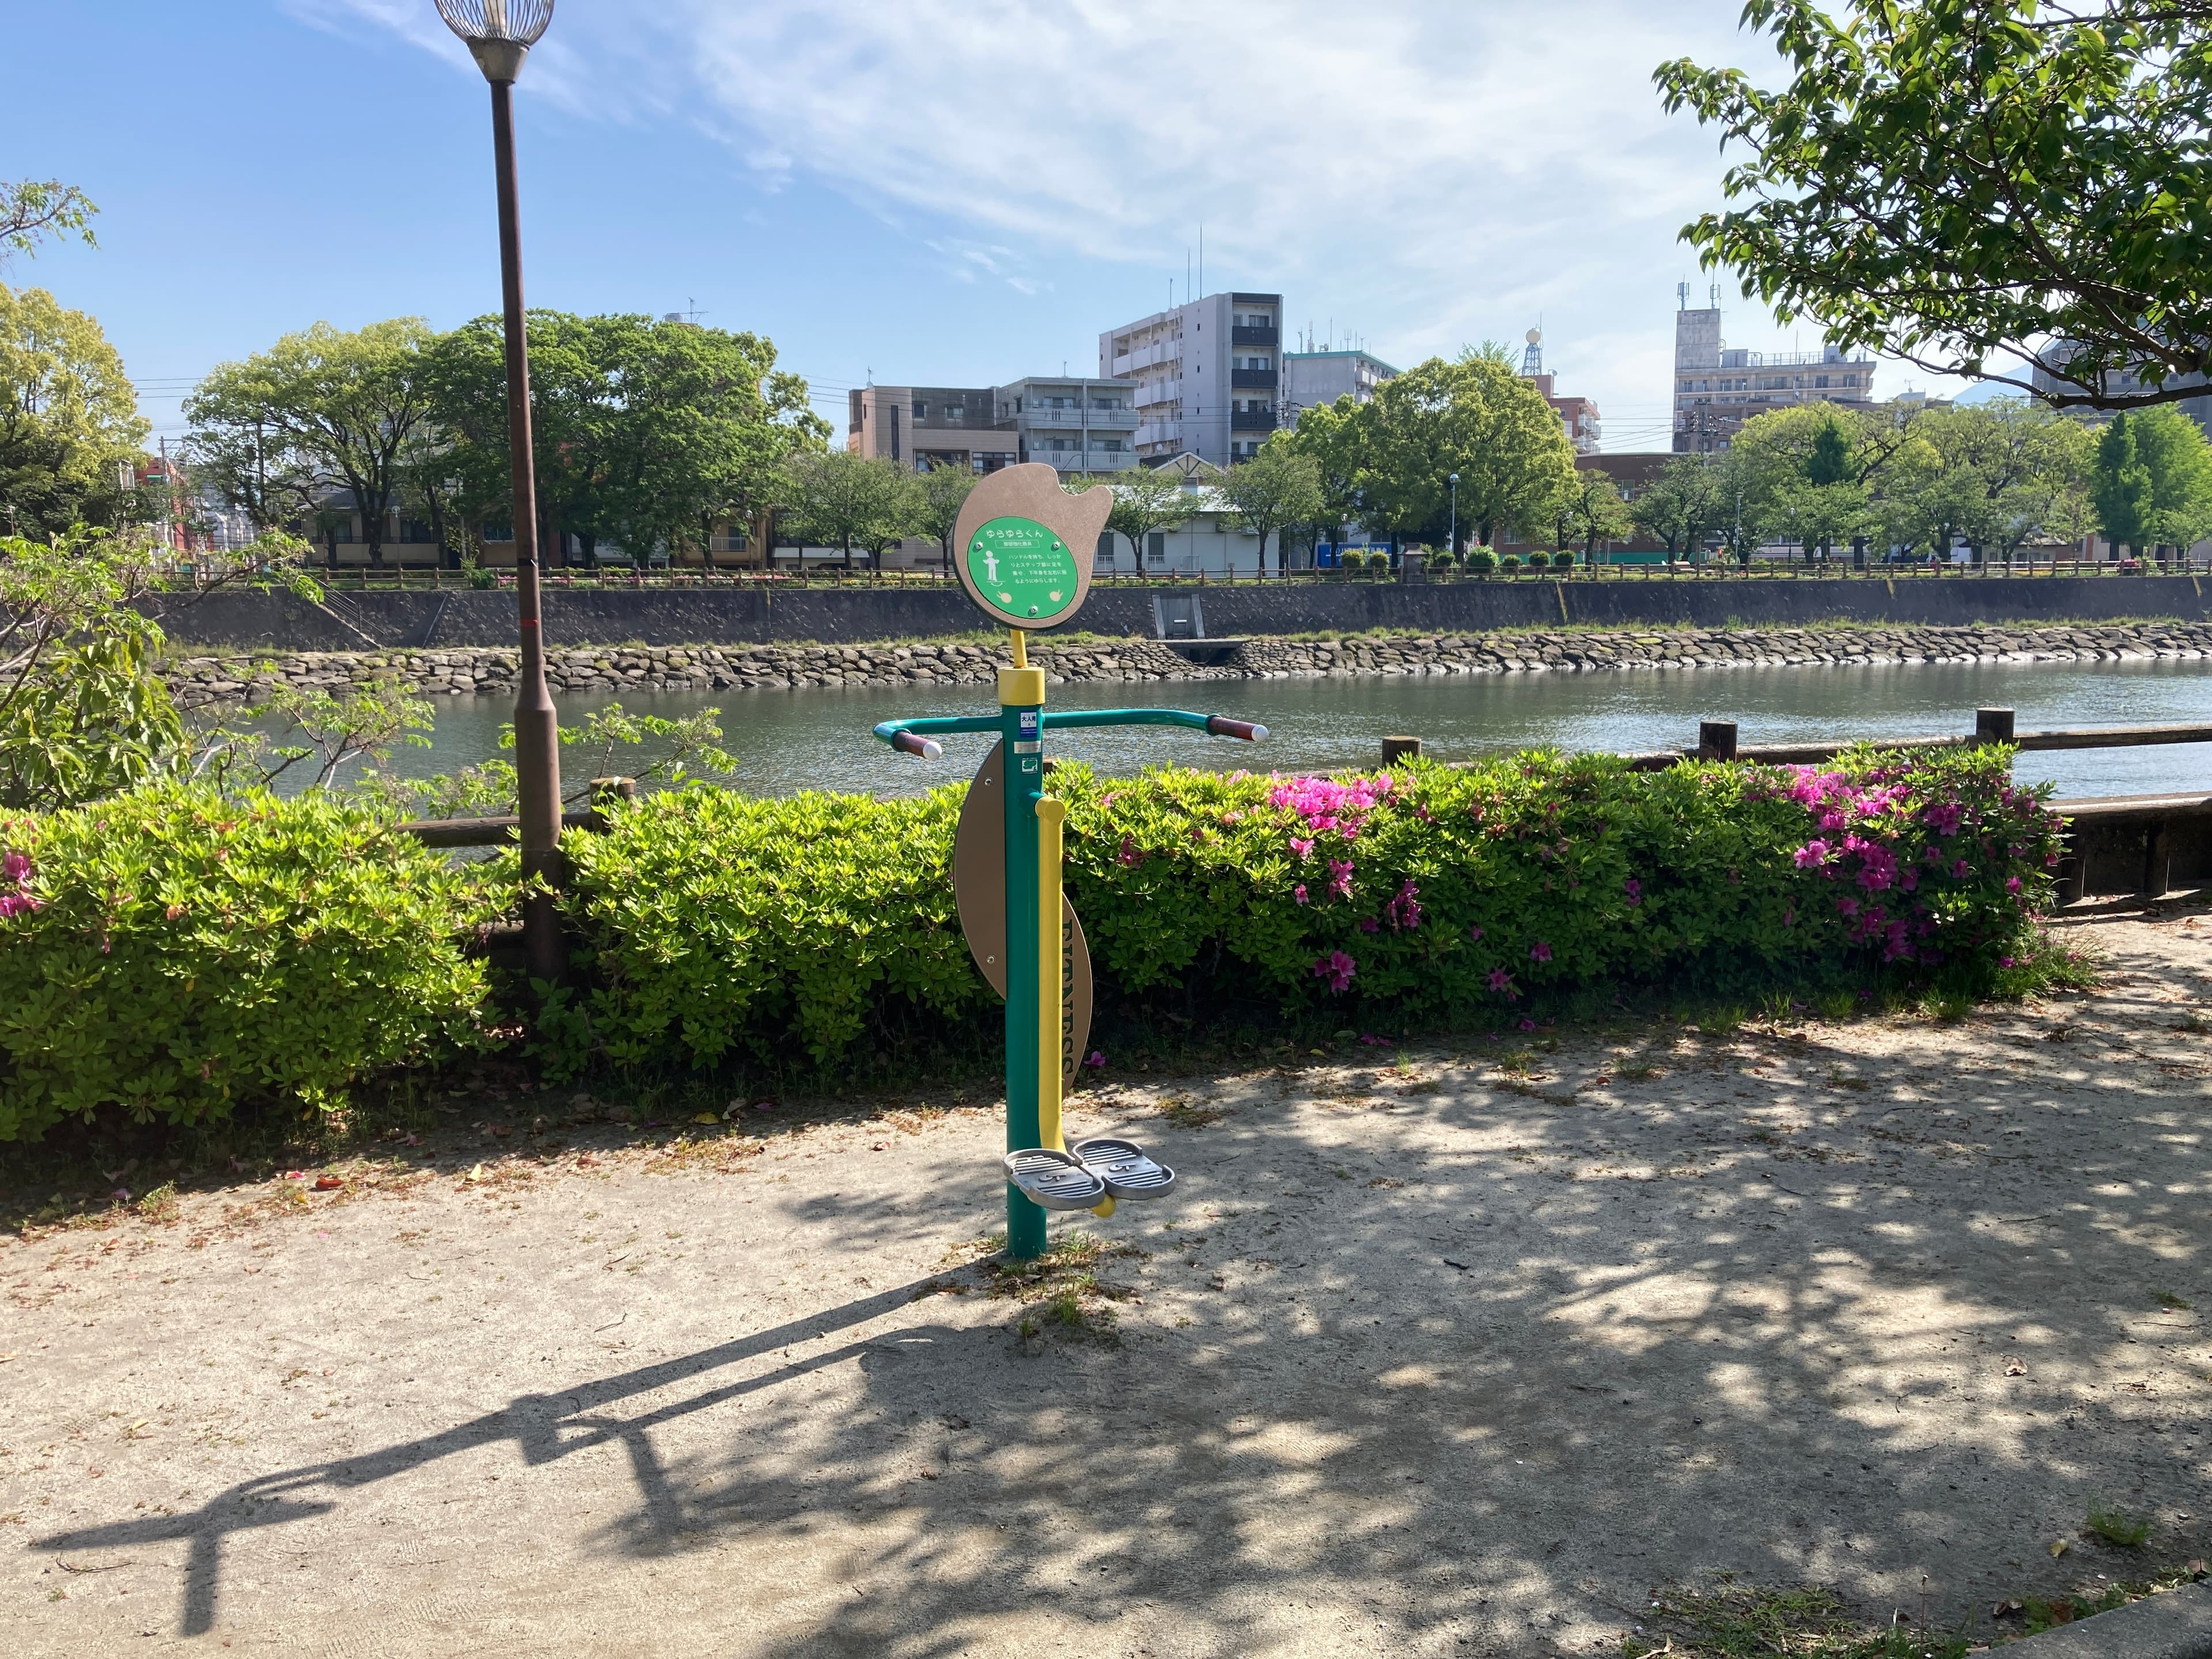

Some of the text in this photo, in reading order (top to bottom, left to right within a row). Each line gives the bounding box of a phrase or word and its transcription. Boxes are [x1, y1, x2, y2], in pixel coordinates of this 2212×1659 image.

[986, 529, 1043, 539] ゆらゆらくん
